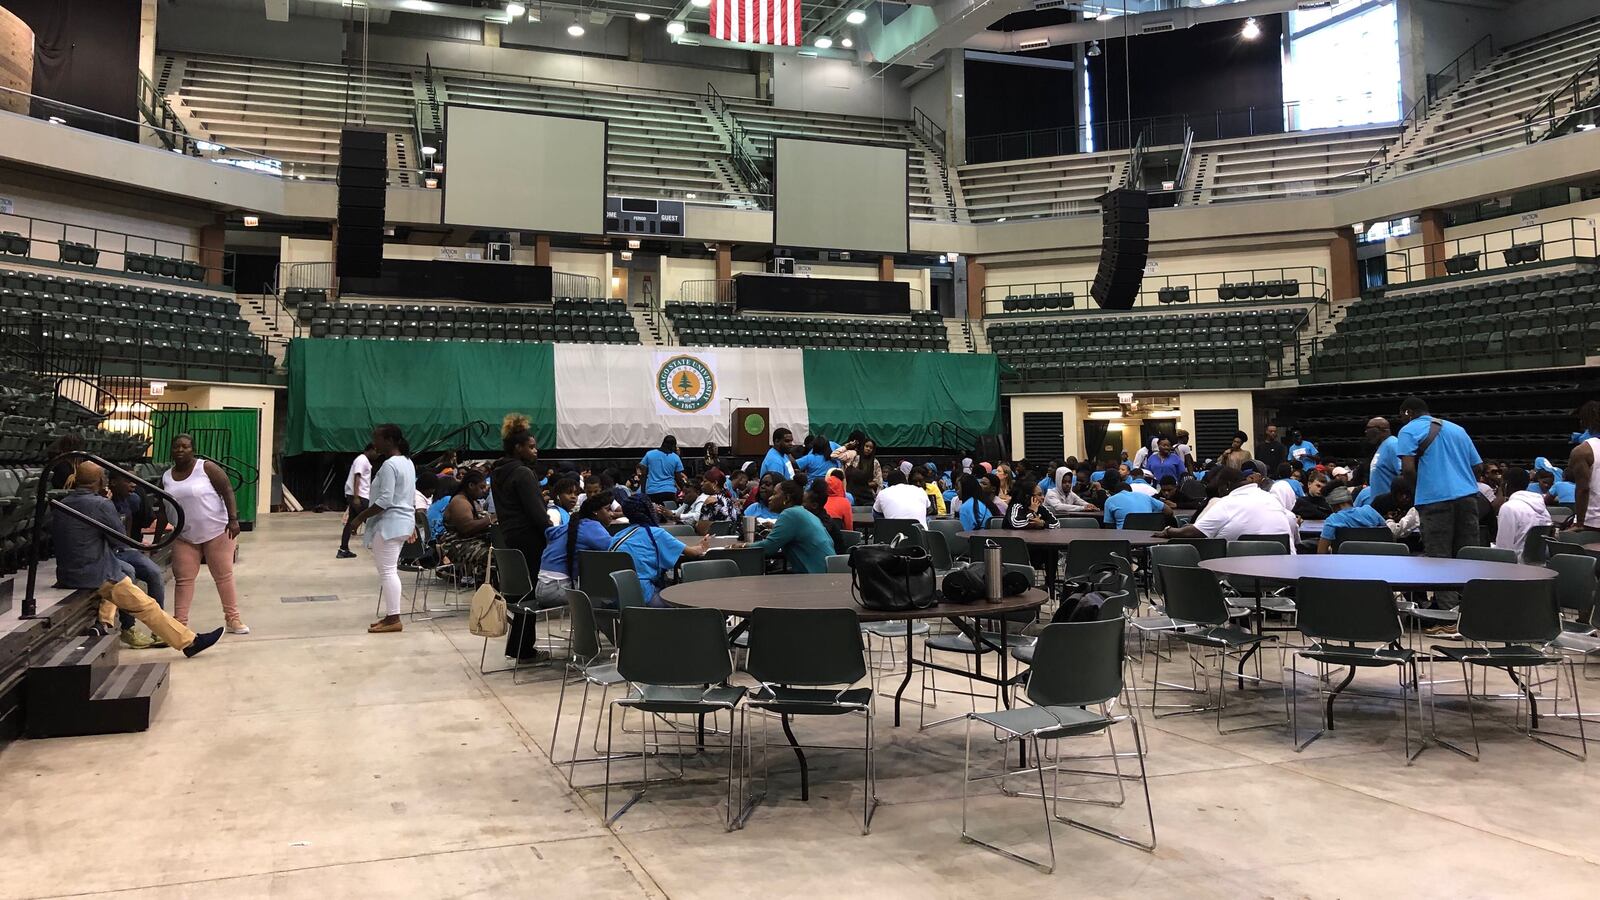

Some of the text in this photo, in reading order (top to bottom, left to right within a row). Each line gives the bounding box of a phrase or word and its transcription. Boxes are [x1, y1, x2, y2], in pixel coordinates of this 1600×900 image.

[660, 368, 673, 402] CHICAGO
[668, 359, 691, 369] STATE
[692, 361, 713, 402] UNIVERSITY
